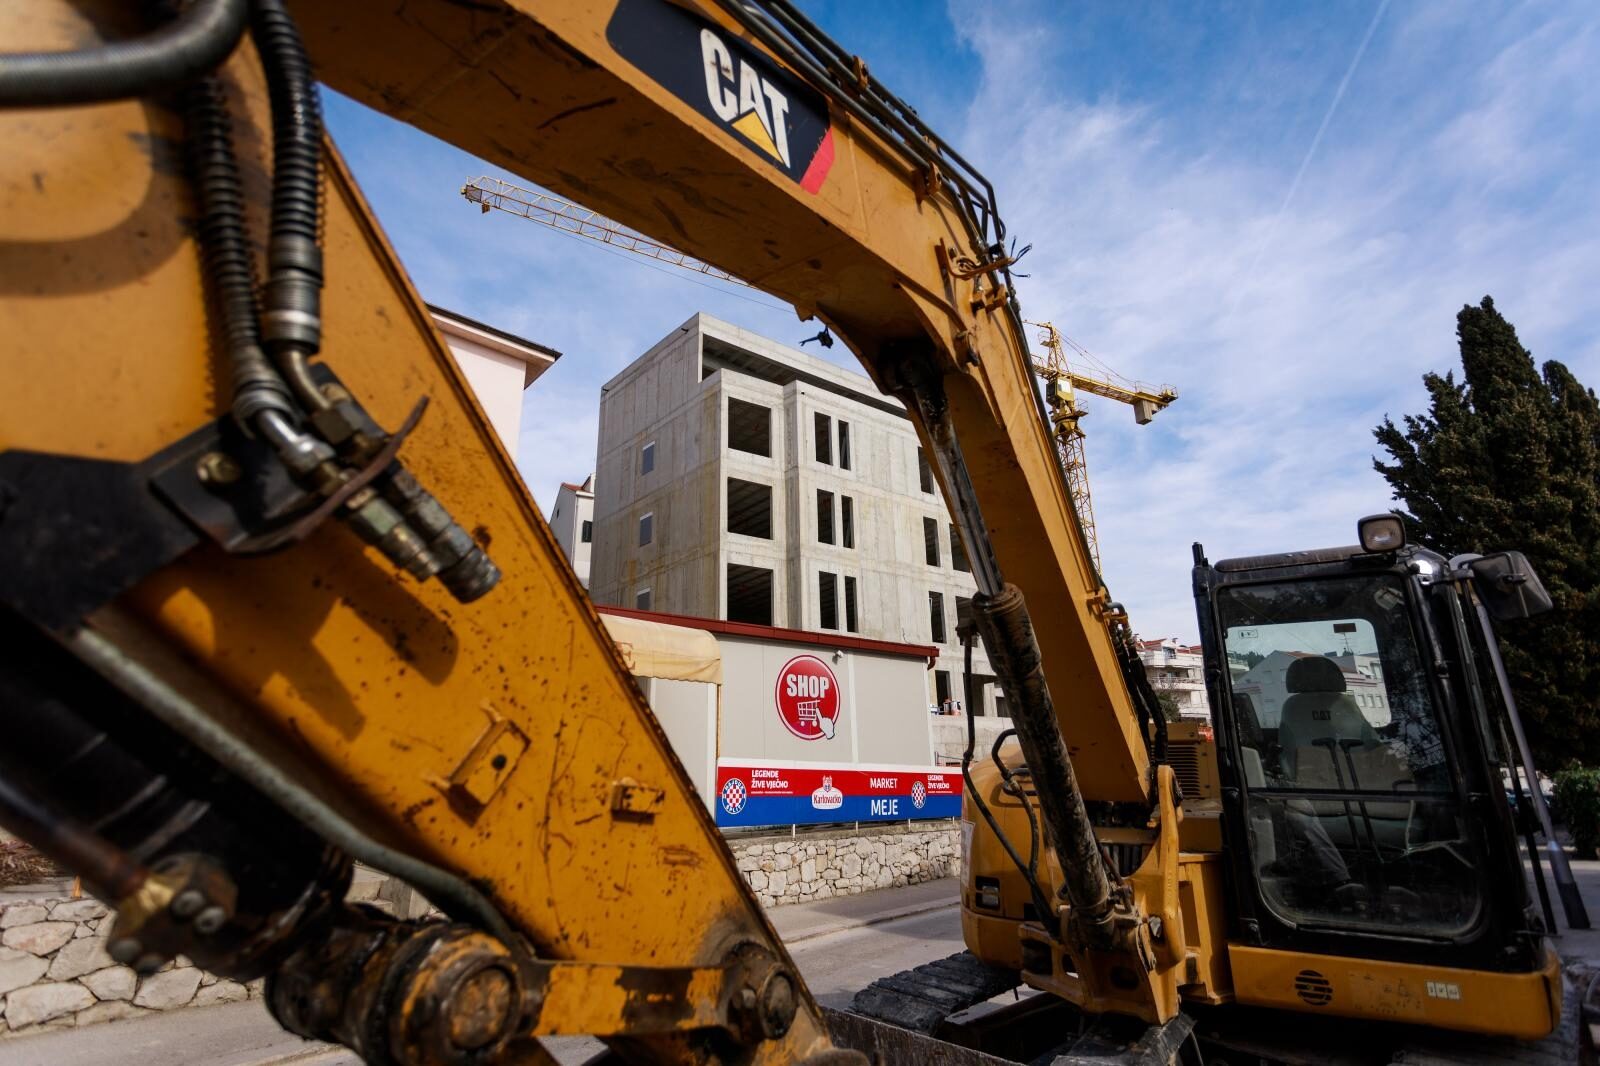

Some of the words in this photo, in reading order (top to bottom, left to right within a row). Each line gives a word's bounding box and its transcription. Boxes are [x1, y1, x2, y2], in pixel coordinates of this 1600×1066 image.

[700, 28, 790, 168] CAT
[786, 673, 829, 698] SHOP
[752, 770, 779, 778] LEGENDE
[752, 778, 766, 788] ŽIVE
[766, 779, 788, 789] VJEČNO
[870, 778, 898, 789] MARKET
[871, 799, 899, 816] MEJE
